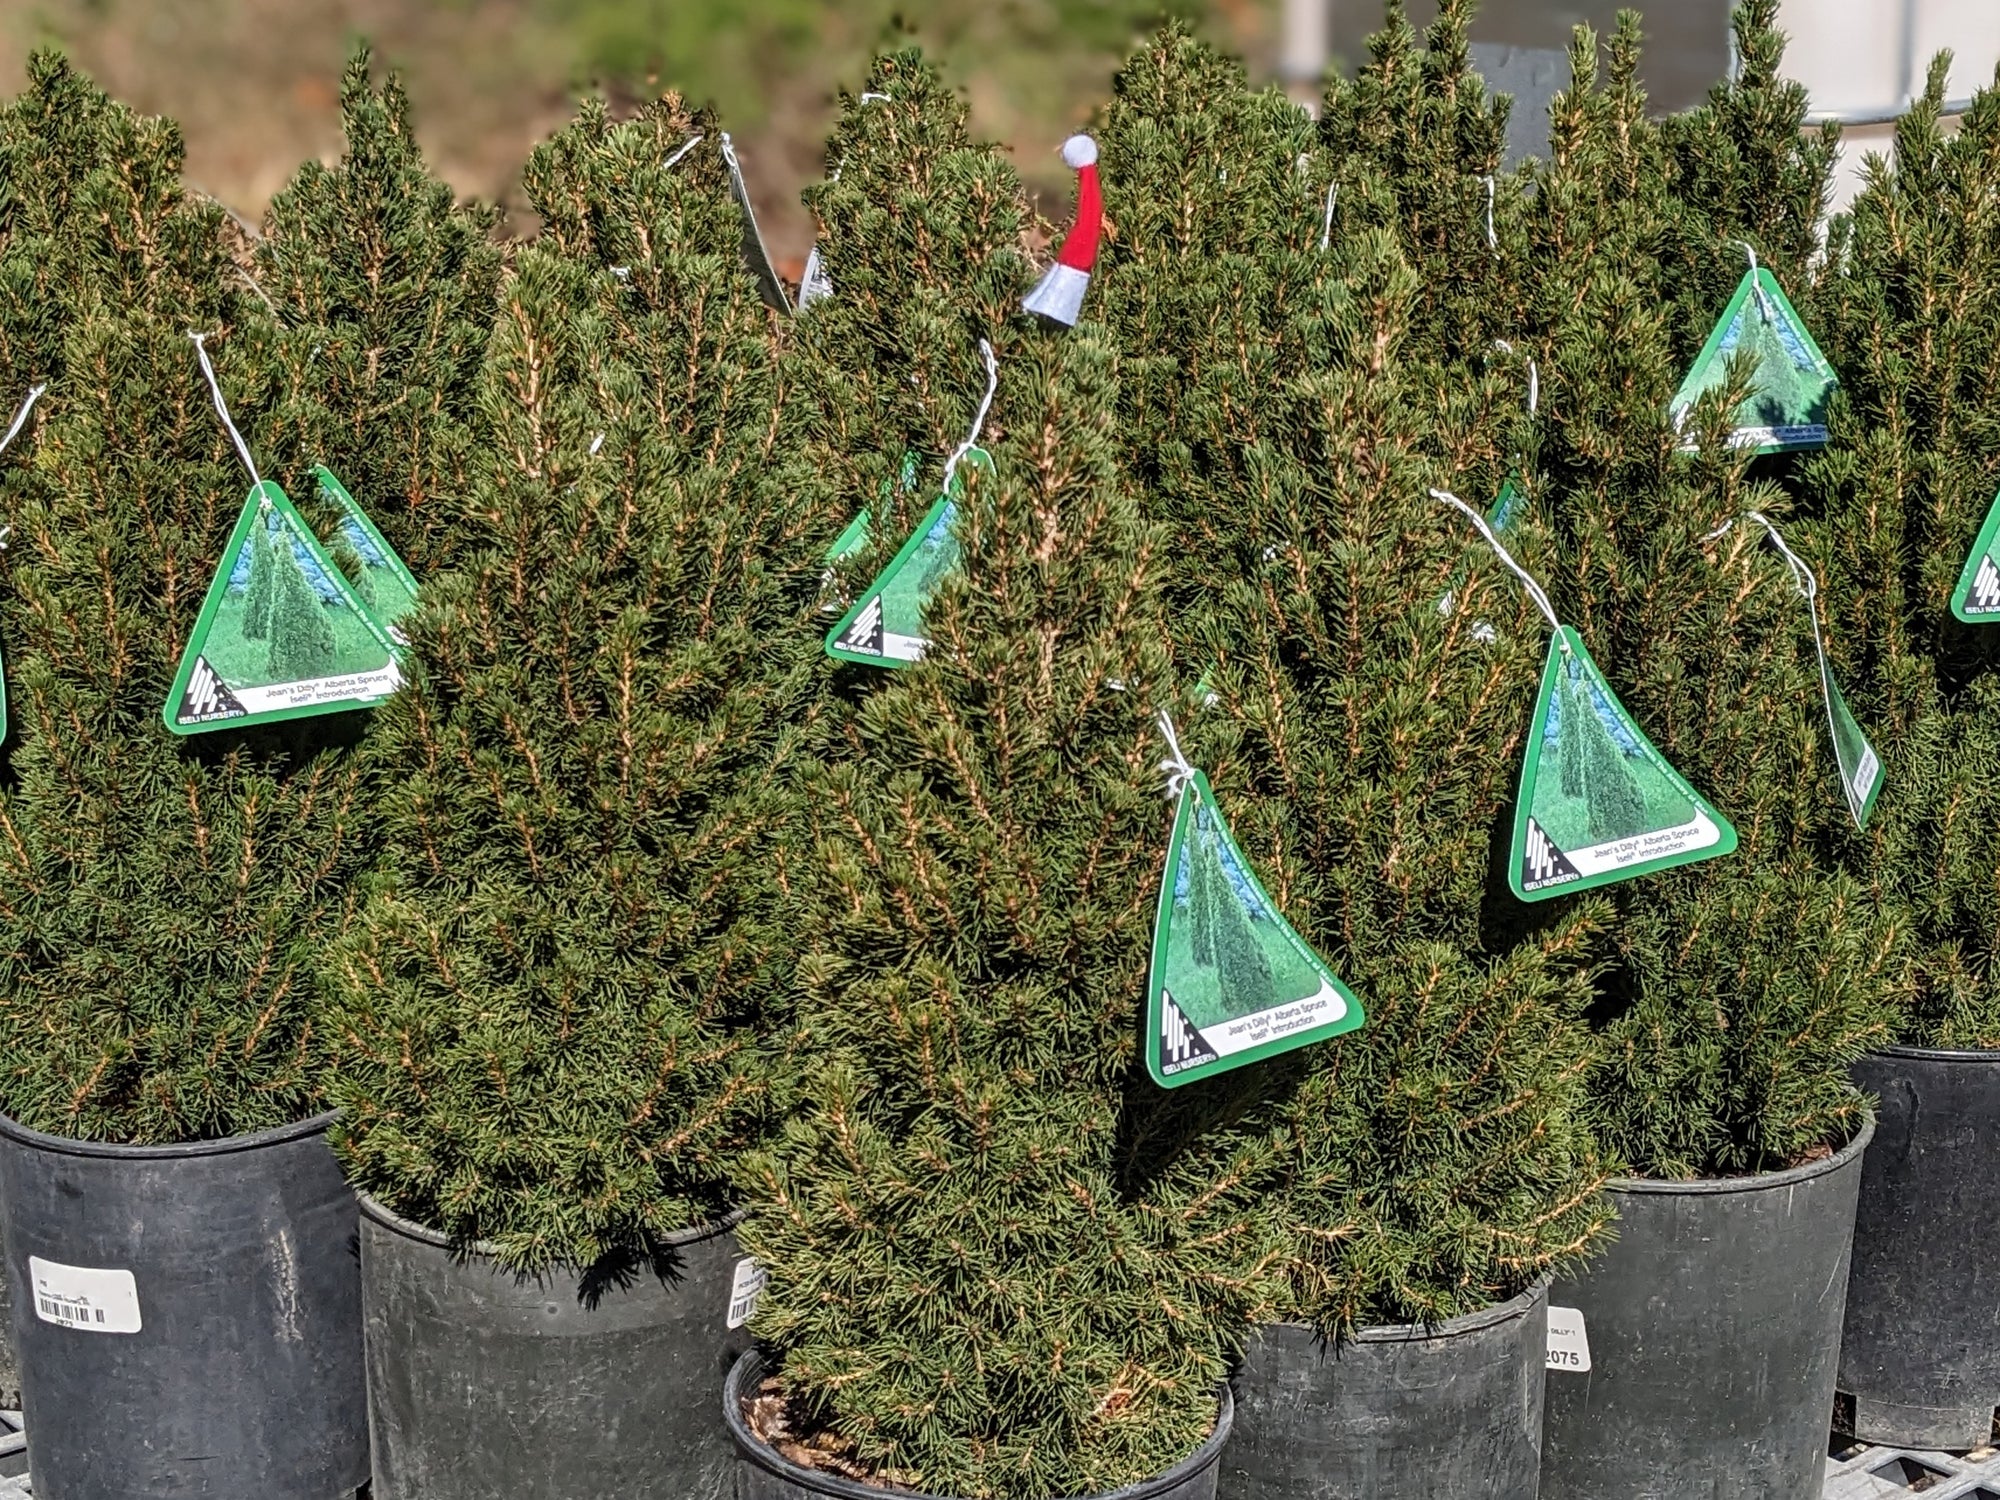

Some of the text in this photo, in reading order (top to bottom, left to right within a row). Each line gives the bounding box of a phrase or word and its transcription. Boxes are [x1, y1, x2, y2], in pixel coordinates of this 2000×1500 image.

[324, 677, 356, 689] Alberta
[357, 673, 389, 686] Spruce
[316, 686, 369, 700] Introduction
[1593, 844, 1619, 858] Jean's
[1643, 833, 1671, 847] Alberta
[1672, 827, 1699, 842] Spruce
[1638, 841, 1686, 858] Introduction
[1228, 1022, 1252, 1036] Jean's
[1274, 1007, 1300, 1021] Alberta
[1300, 999, 1328, 1015] Spruce
[1270, 1014, 1315, 1035] Introduction
